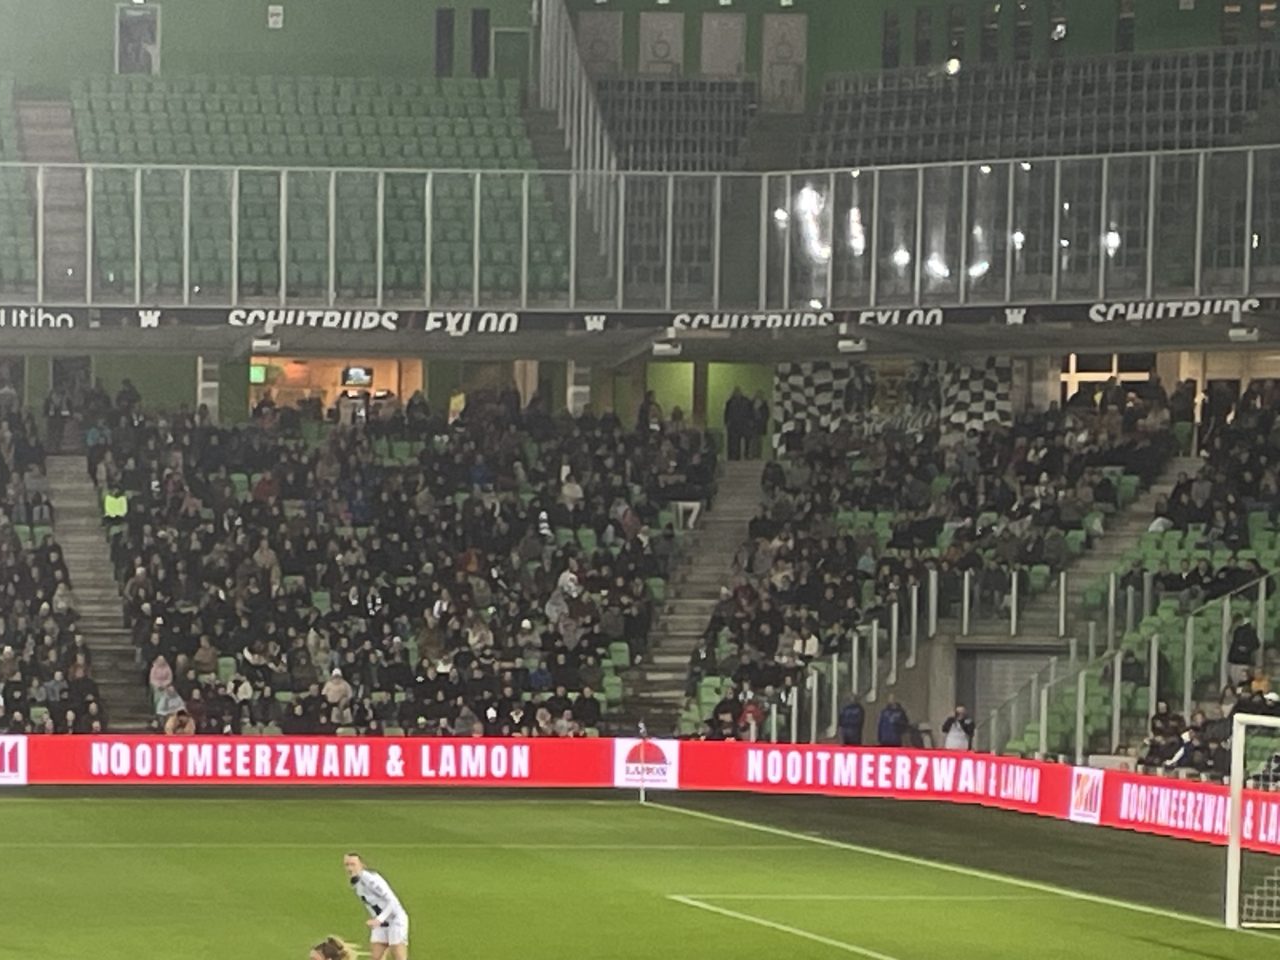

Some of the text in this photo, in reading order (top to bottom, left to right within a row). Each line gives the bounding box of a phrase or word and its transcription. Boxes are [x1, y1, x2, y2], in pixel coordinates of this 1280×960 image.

[92, 743, 528, 777] NOOITMEERZWAM & LAMON
[747, 749, 986, 795] NOOITMEERZWAM
[1259, 800, 1280, 844] LA
